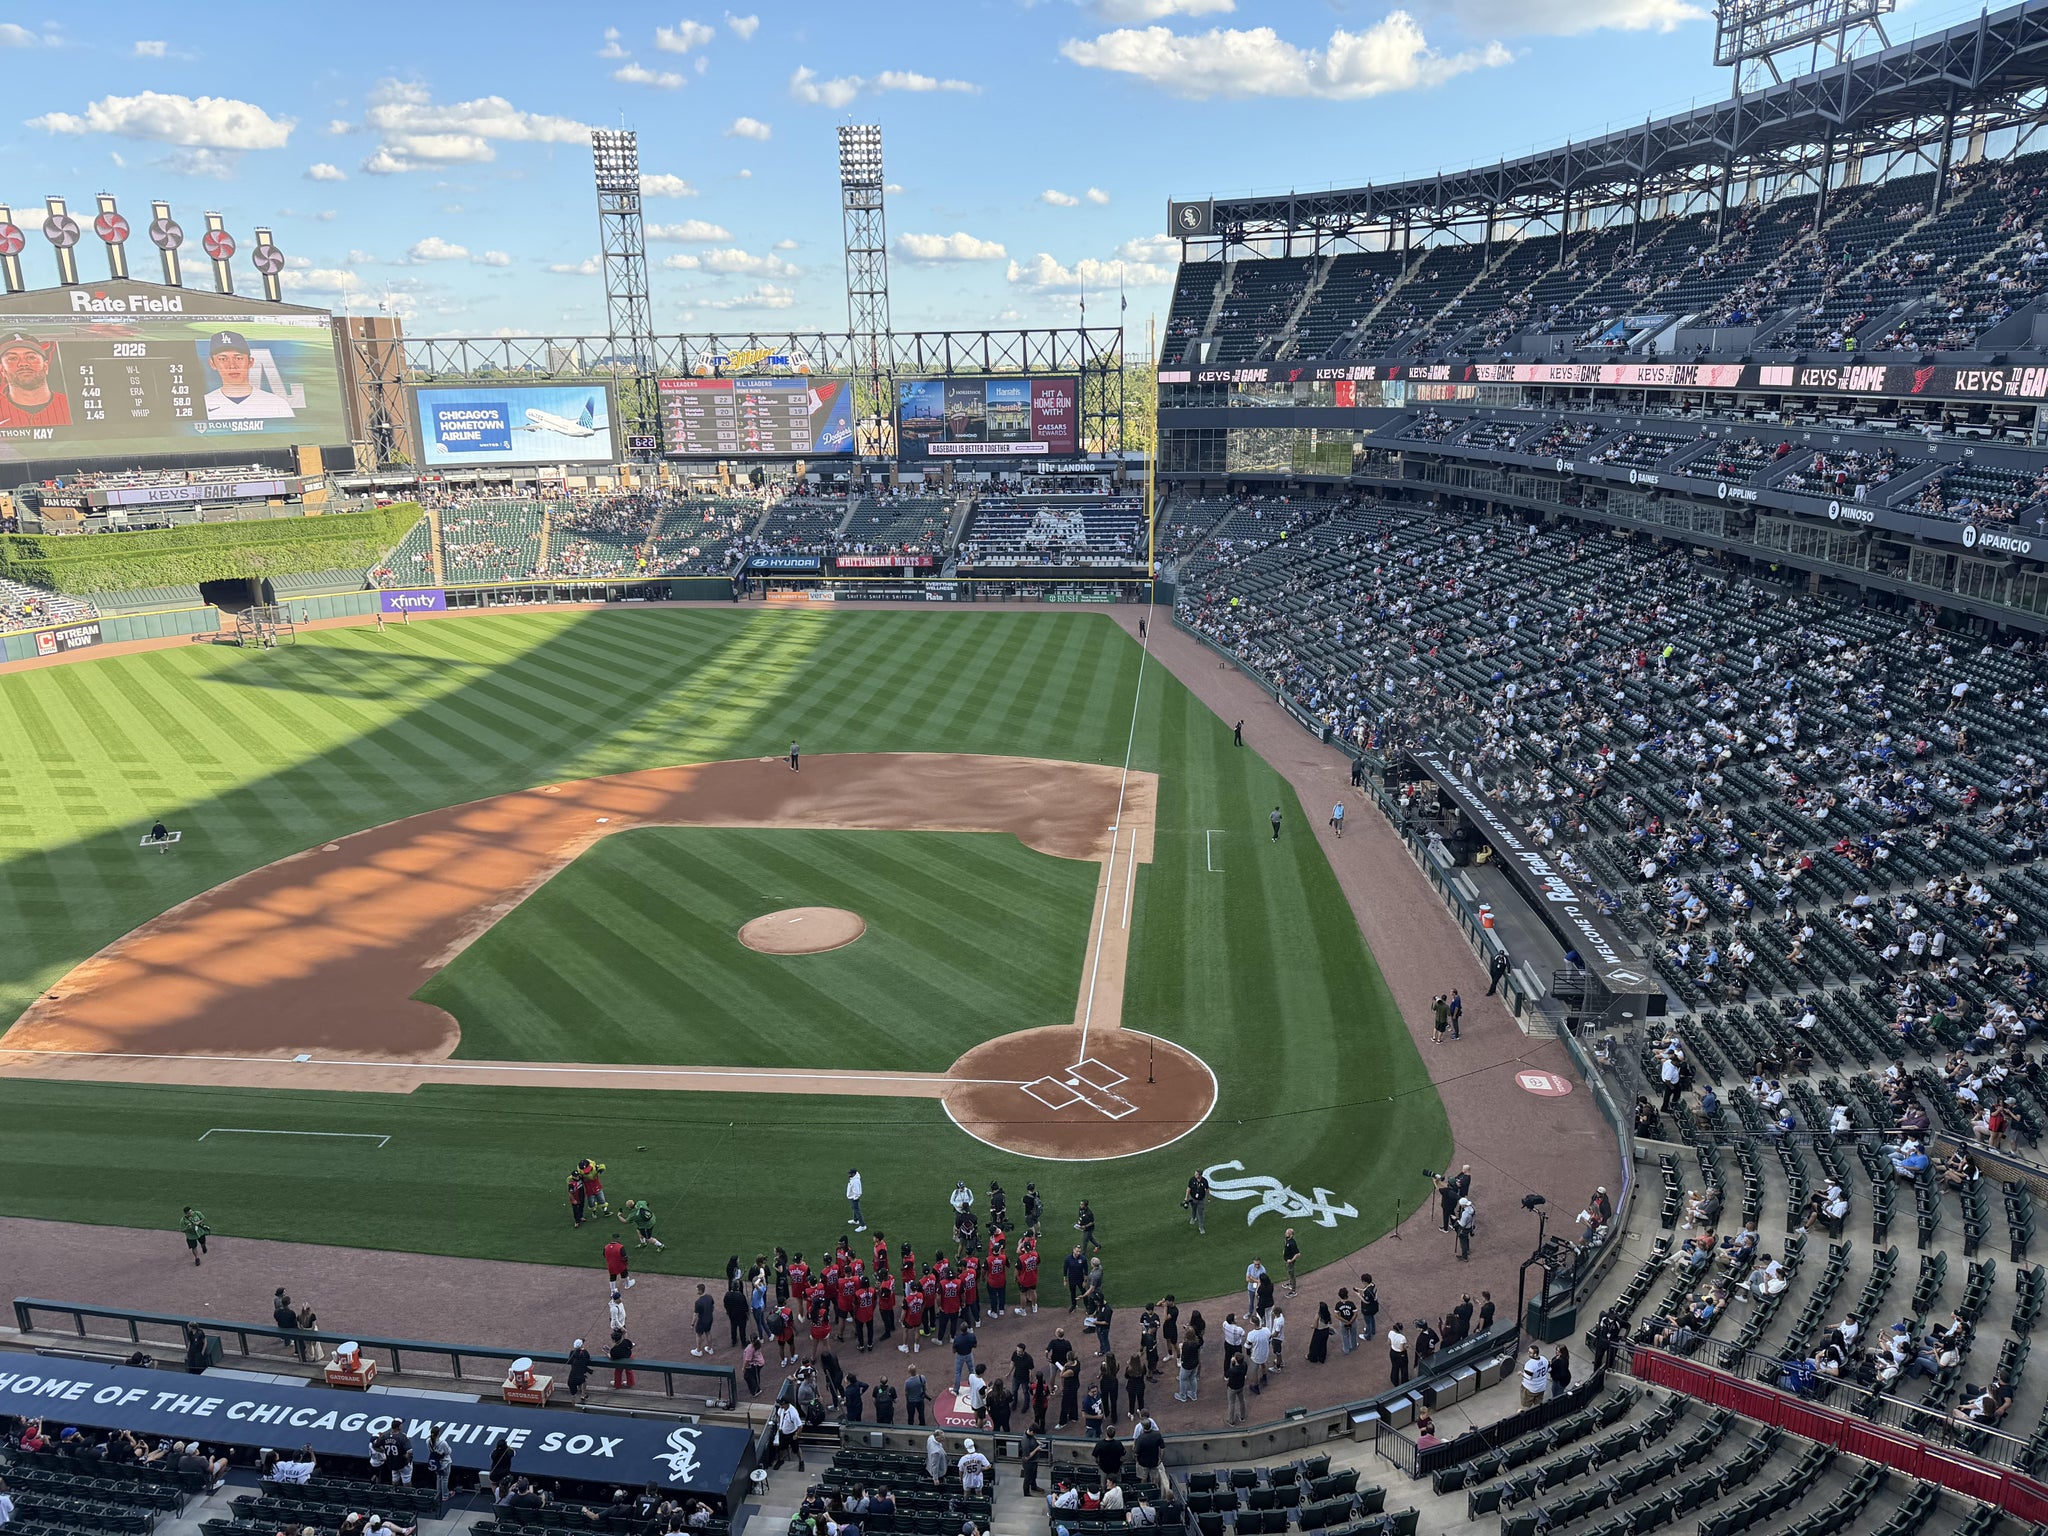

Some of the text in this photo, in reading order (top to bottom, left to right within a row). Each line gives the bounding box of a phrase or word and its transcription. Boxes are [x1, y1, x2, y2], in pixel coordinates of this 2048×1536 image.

[70, 291, 183, 312] Rate Field
[113, 343, 146, 357] 2026
[767, 355, 790, 365] TIME
[80, 366, 94, 375] 5-1
[126, 366, 140, 374] W-L
[170, 365, 183, 373] 3-3
[1316, 366, 1376, 380] KEYS GAME
[1409, 365, 1451, 380] KEYS GAME
[1497, 366, 1515, 380] GAME
[1550, 365, 1602, 382] KEYS GAME
[173, 375, 183, 384] 11
[1199, 369, 1268, 382] KEYS GAME
[1638, 368, 1664, 382] KEYS
[1674, 366, 1699, 384] GAME
[1800, 366, 1886, 391] KEYS TO THE GAME
[2012, 368, 2022, 381] TO
[84, 377, 94, 385] 11
[130, 377, 140, 385] GS
[1954, 371, 2003, 391] KEYS
[82, 388, 100, 397] 4.40
[130, 388, 144, 396] ERA
[171, 386, 189, 395] 4.03
[1057, 390, 1063, 398] A
[2004, 382, 2020, 396] THE
[84, 400, 102, 409] 61.1
[135, 399, 142, 407] IP
[174, 398, 191, 406] 58.0
[1034, 397, 1071, 408] HOME RUN
[87, 411, 104, 420] 1.45
[131, 410, 150, 418] WHIP
[176, 408, 192, 417] 1.26
[439, 410, 499, 420] CHICAGO'S
[231, 420, 264, 431] SASAKI
[440, 421, 504, 431] HOMETOWN
[34, 428, 54, 439] KAY
[442, 431, 481, 441] AIRLINE
[823, 427, 852, 445] Dodgers
[933, 445, 959, 453] BASEBALL
[965, 444, 984, 452] BETTER
[984, 444, 1010, 452] TOGETHER
[1037, 462, 1096, 474] Lite LANDING
[1564, 462, 1575, 471] FOX
[1638, 473, 1659, 484] BAINES
[149, 489, 190, 500] KEYS
[204, 485, 237, 498] GAME
[1728, 488, 1757, 500] APPLING
[43, 498, 81, 507] FAN DECK
[1966, 531, 2031, 553] 11 APARICIO
[770, 559, 814, 567] HYUNDAI
[838, 557, 892, 567] WHITTINGHAM
[894, 557, 920, 566] MEATS
[926, 592, 943, 600] Rate
[390, 594, 436, 609] xfinity
[56, 625, 99, 640] STREAM
[67, 635, 92, 648] NOW
[1428, 760, 1524, 849] HOME OF THE CHICAGO WHITE SOX
[1515, 852, 1621, 964] WELCOME TO Rate Field
[329, 1373, 360, 1383] GATORADE
[1536, 1369, 1546, 1378] 72
[507, 1391, 539, 1400] GATORADE
[0, 1372, 624, 1458] HOME OF THE CHICAGO WHITE SOX
[945, 1417, 992, 1428] TOYOA
[967, 1464, 978, 1473] 55
[642, 1504, 650, 1516] 7
